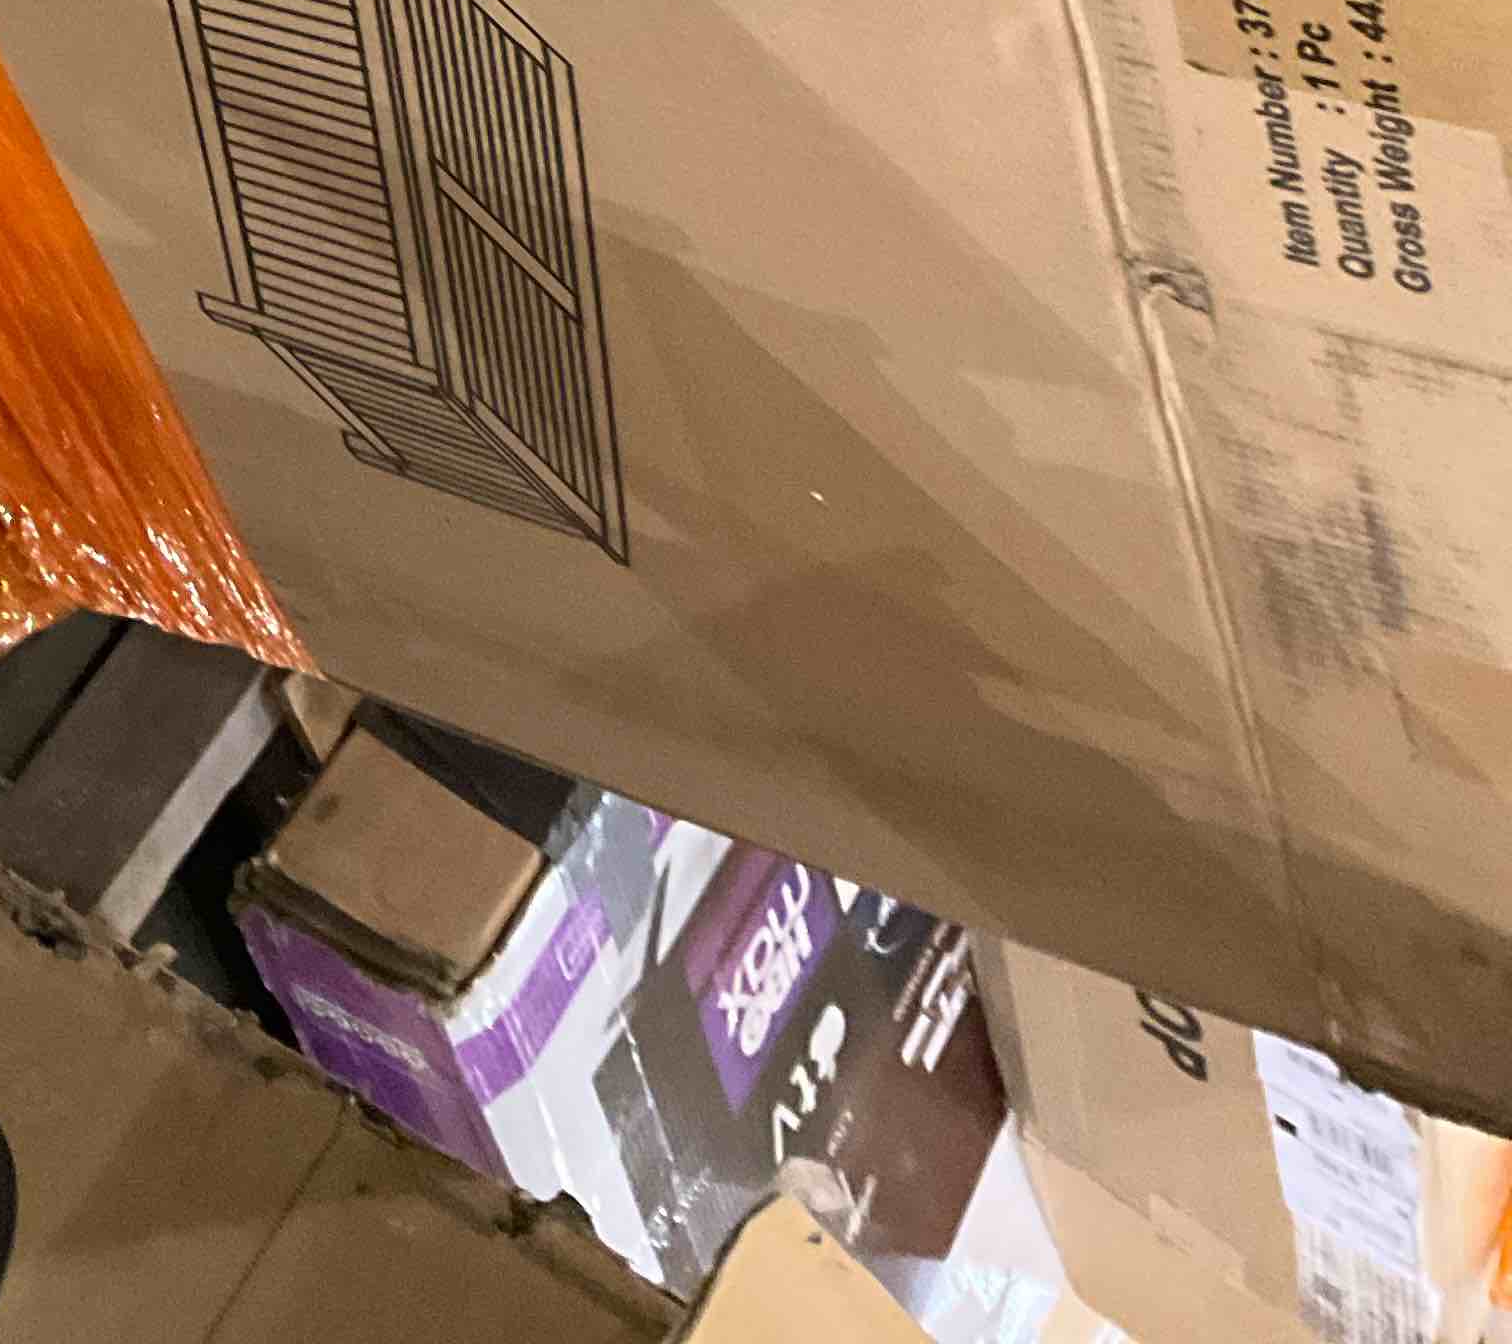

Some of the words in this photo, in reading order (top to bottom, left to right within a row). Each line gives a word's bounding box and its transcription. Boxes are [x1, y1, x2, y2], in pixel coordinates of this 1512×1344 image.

[1295, 20, 1338, 67] Pc
[1253, 62, 1307, 195] Number
[1360, 78, 1416, 193] Weight
[1281, 200, 1321, 268] Item
[1321, 147, 1376, 280] Quantity
[1390, 200, 1433, 294] Gross
